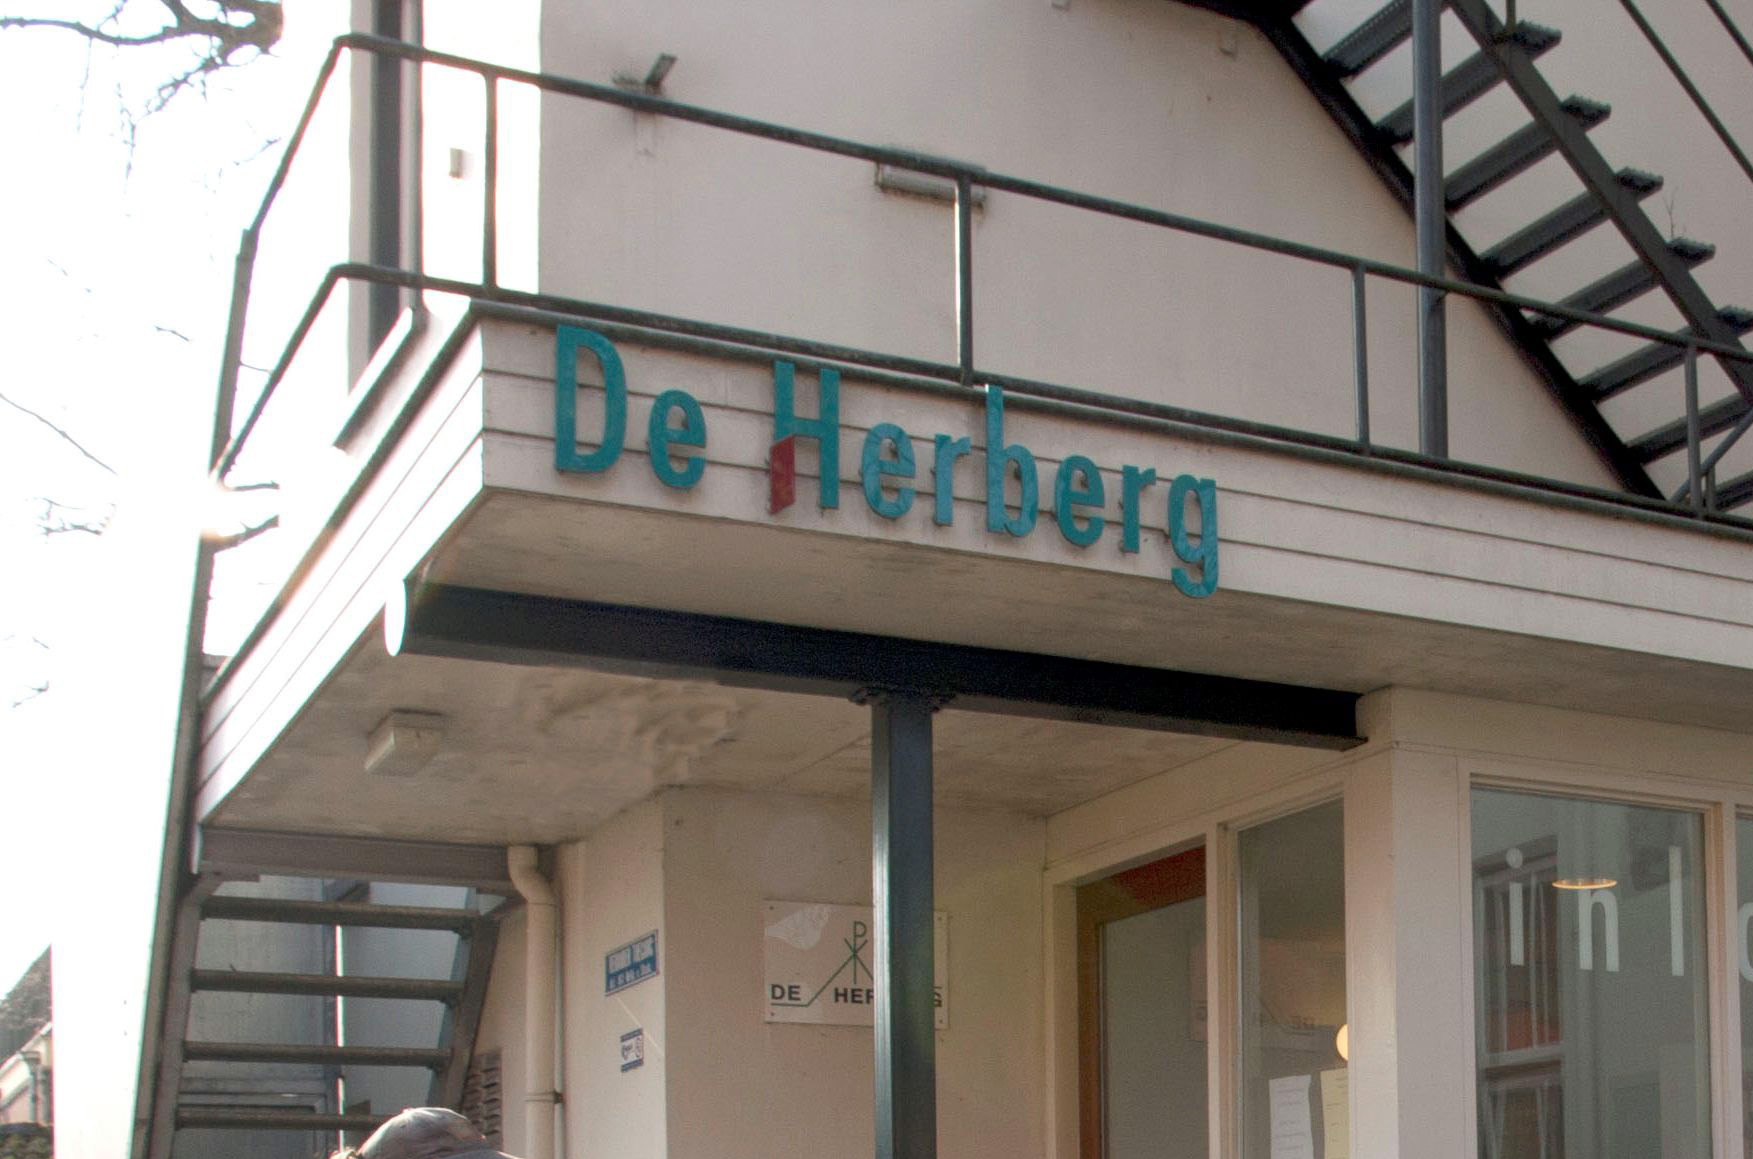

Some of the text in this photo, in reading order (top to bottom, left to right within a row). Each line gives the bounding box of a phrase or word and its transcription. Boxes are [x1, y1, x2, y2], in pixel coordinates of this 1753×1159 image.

[554, 325, 1220, 598] De Herberg
[770, 983, 802, 1002] DE
